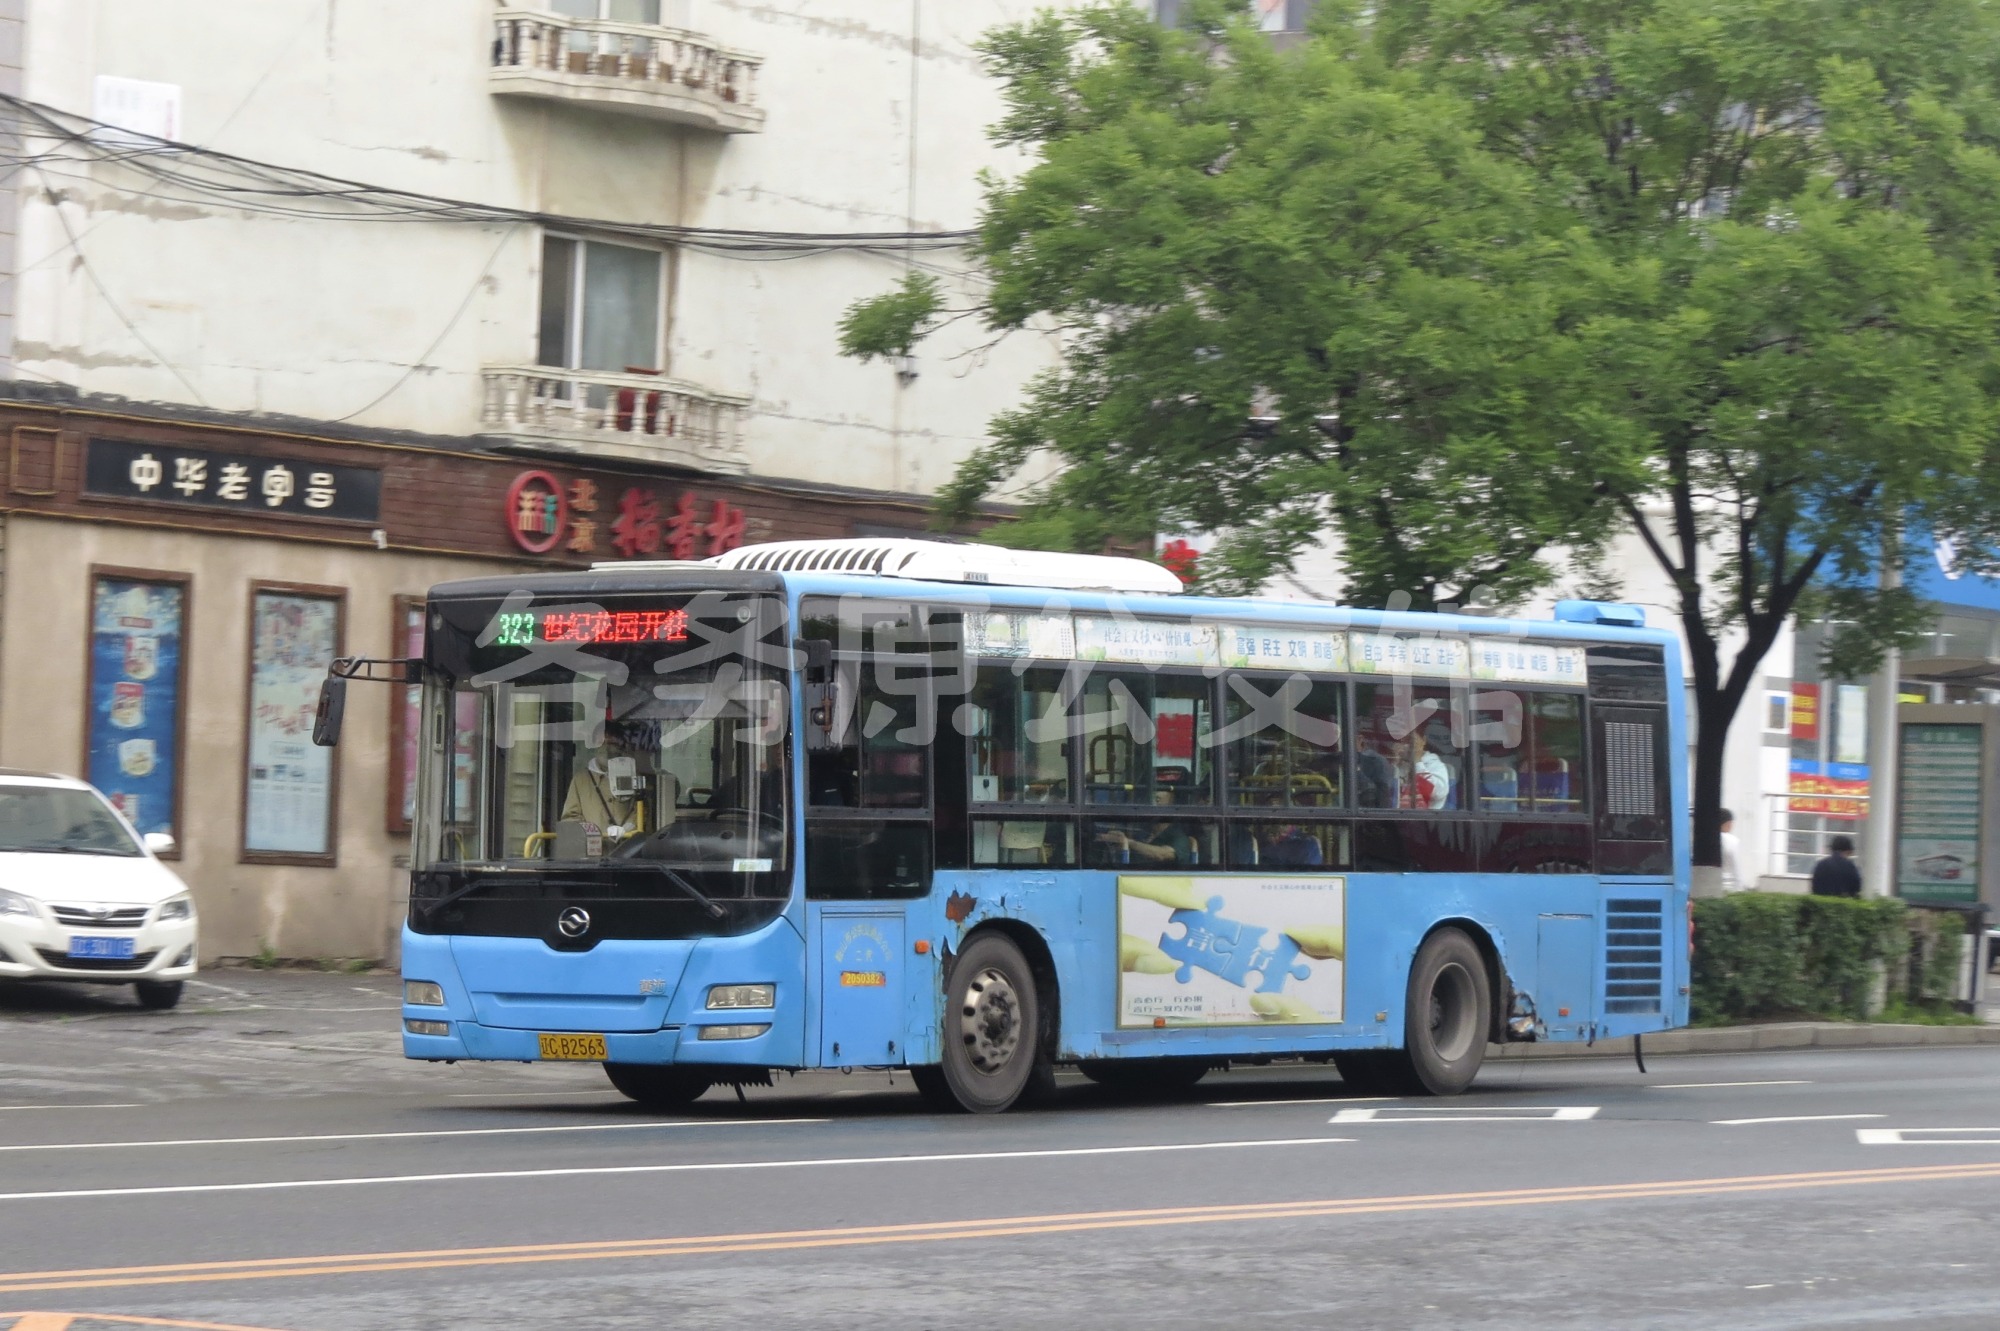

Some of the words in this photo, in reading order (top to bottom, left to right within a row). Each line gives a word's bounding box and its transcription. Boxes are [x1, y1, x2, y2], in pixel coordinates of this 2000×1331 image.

[129, 453, 337, 508] 中华老字号
[498, 612, 534, 645] 323
[542, 609, 689, 642] 世纪花园开往
[1236, 636, 1256, 656] 富强
[1262, 638, 1282, 657] 民主
[1413, 647, 1431, 665] 公正
